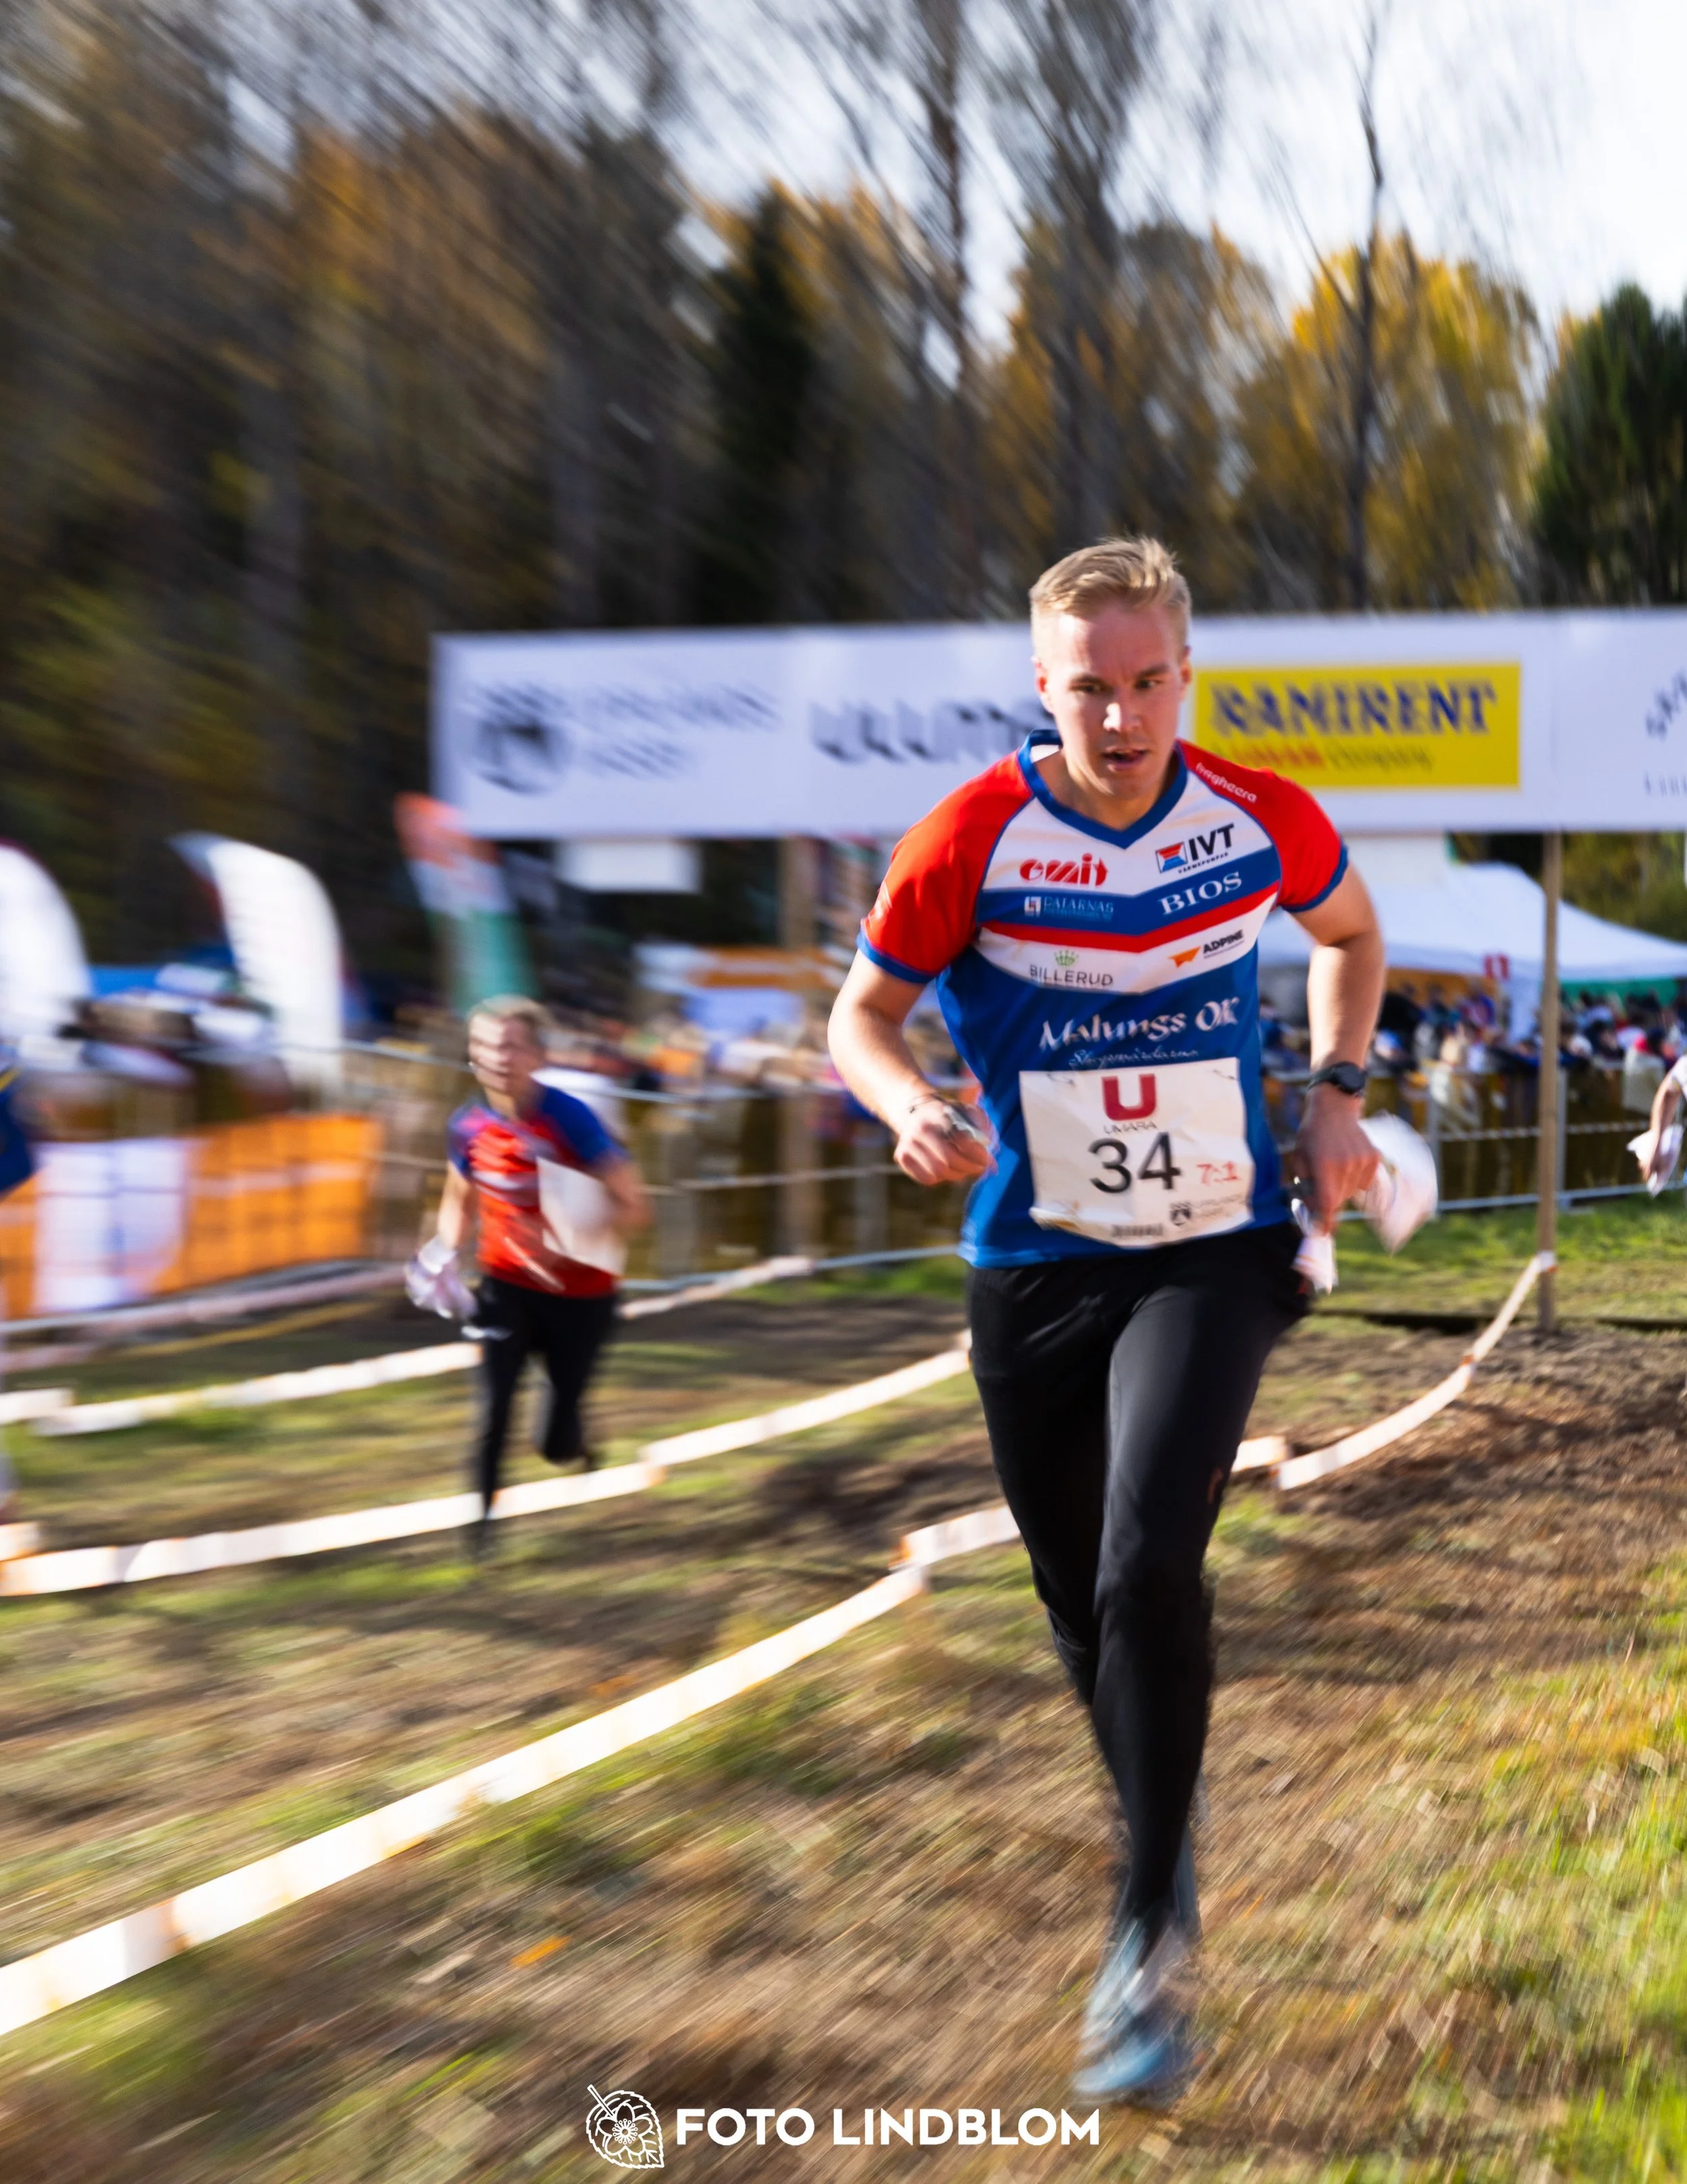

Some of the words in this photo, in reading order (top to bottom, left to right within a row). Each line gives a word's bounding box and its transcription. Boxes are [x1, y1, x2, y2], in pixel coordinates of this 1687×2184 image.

[1188, 823, 1234, 861] IVT
[1020, 852, 1108, 888] emit
[1158, 871, 1242, 915] BIOS
[1203, 929, 1244, 954] ADPINE
[1030, 964, 1113, 986] BILLERUD
[1195, 997, 1240, 1031] OK
[1101, 1072, 1157, 1122] U
[1088, 1131, 1182, 1194] 34
